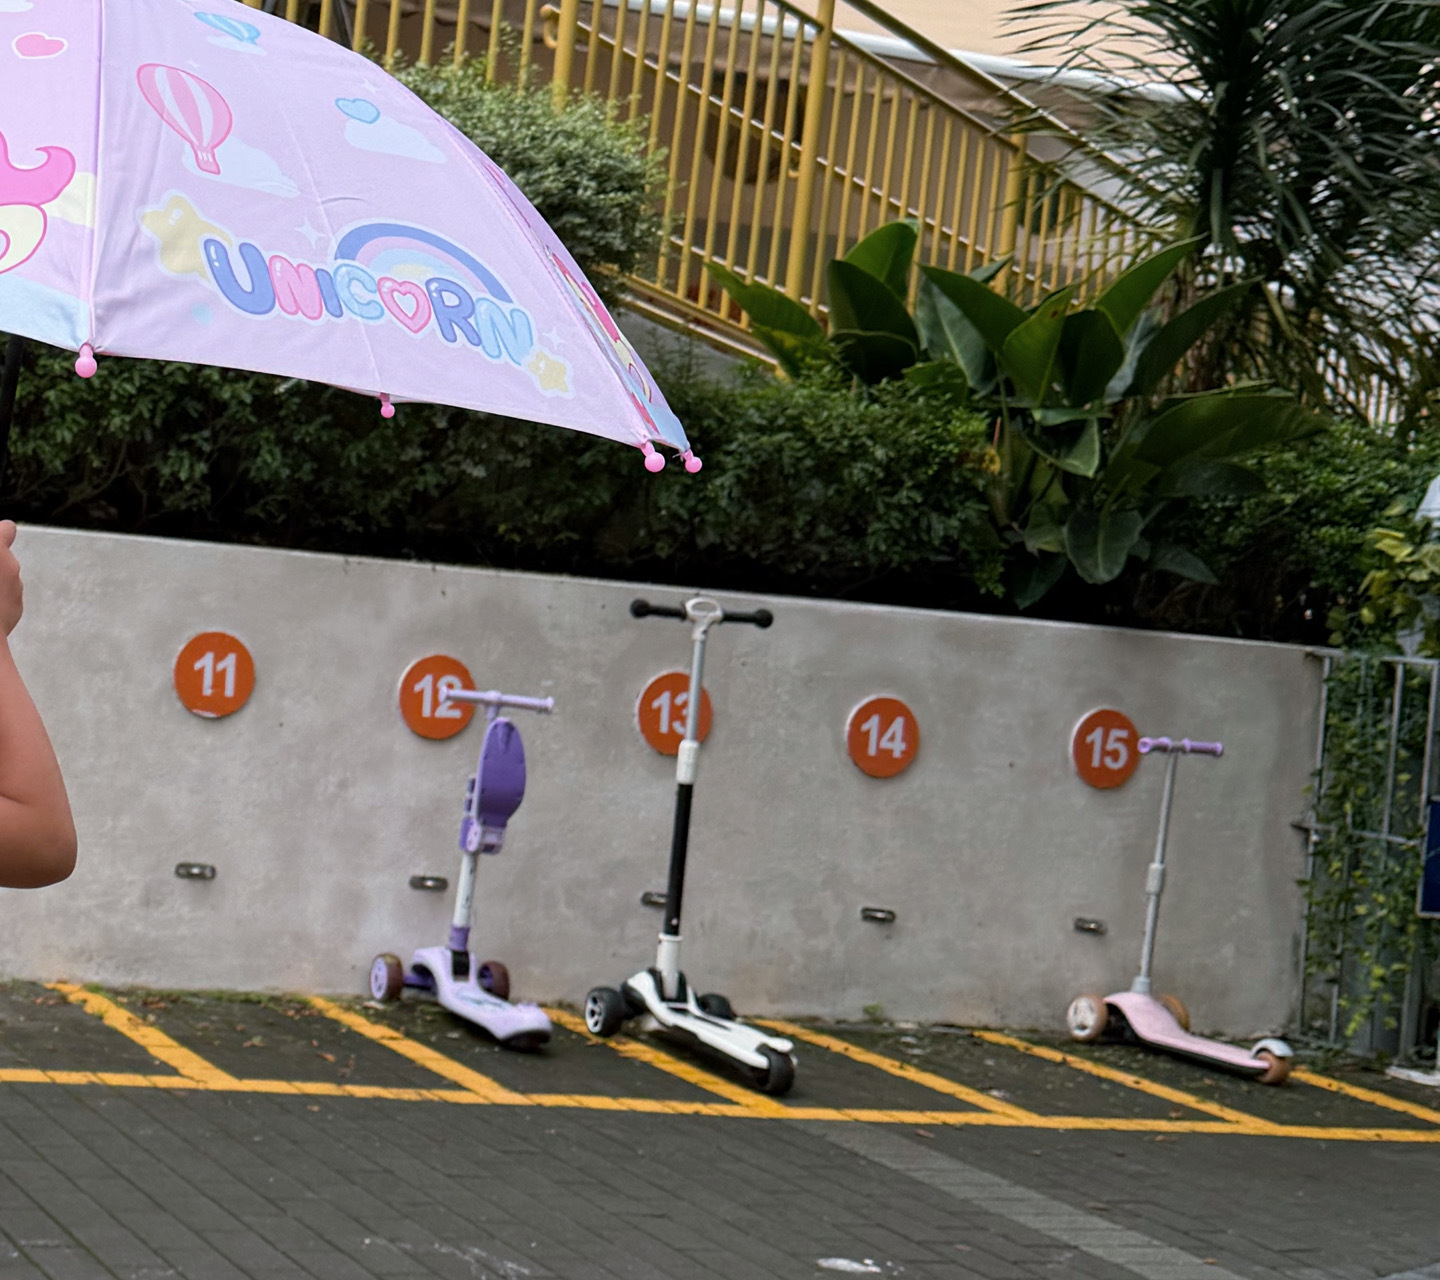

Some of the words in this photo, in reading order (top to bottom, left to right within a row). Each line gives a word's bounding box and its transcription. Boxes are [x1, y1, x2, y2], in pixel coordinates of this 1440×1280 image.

[203, 237, 535, 366] UNICORN
[193, 651, 238, 698] 11
[413, 673, 463, 719] 12
[859, 713, 907, 760] 14
[1084, 726, 1130, 771] 15
